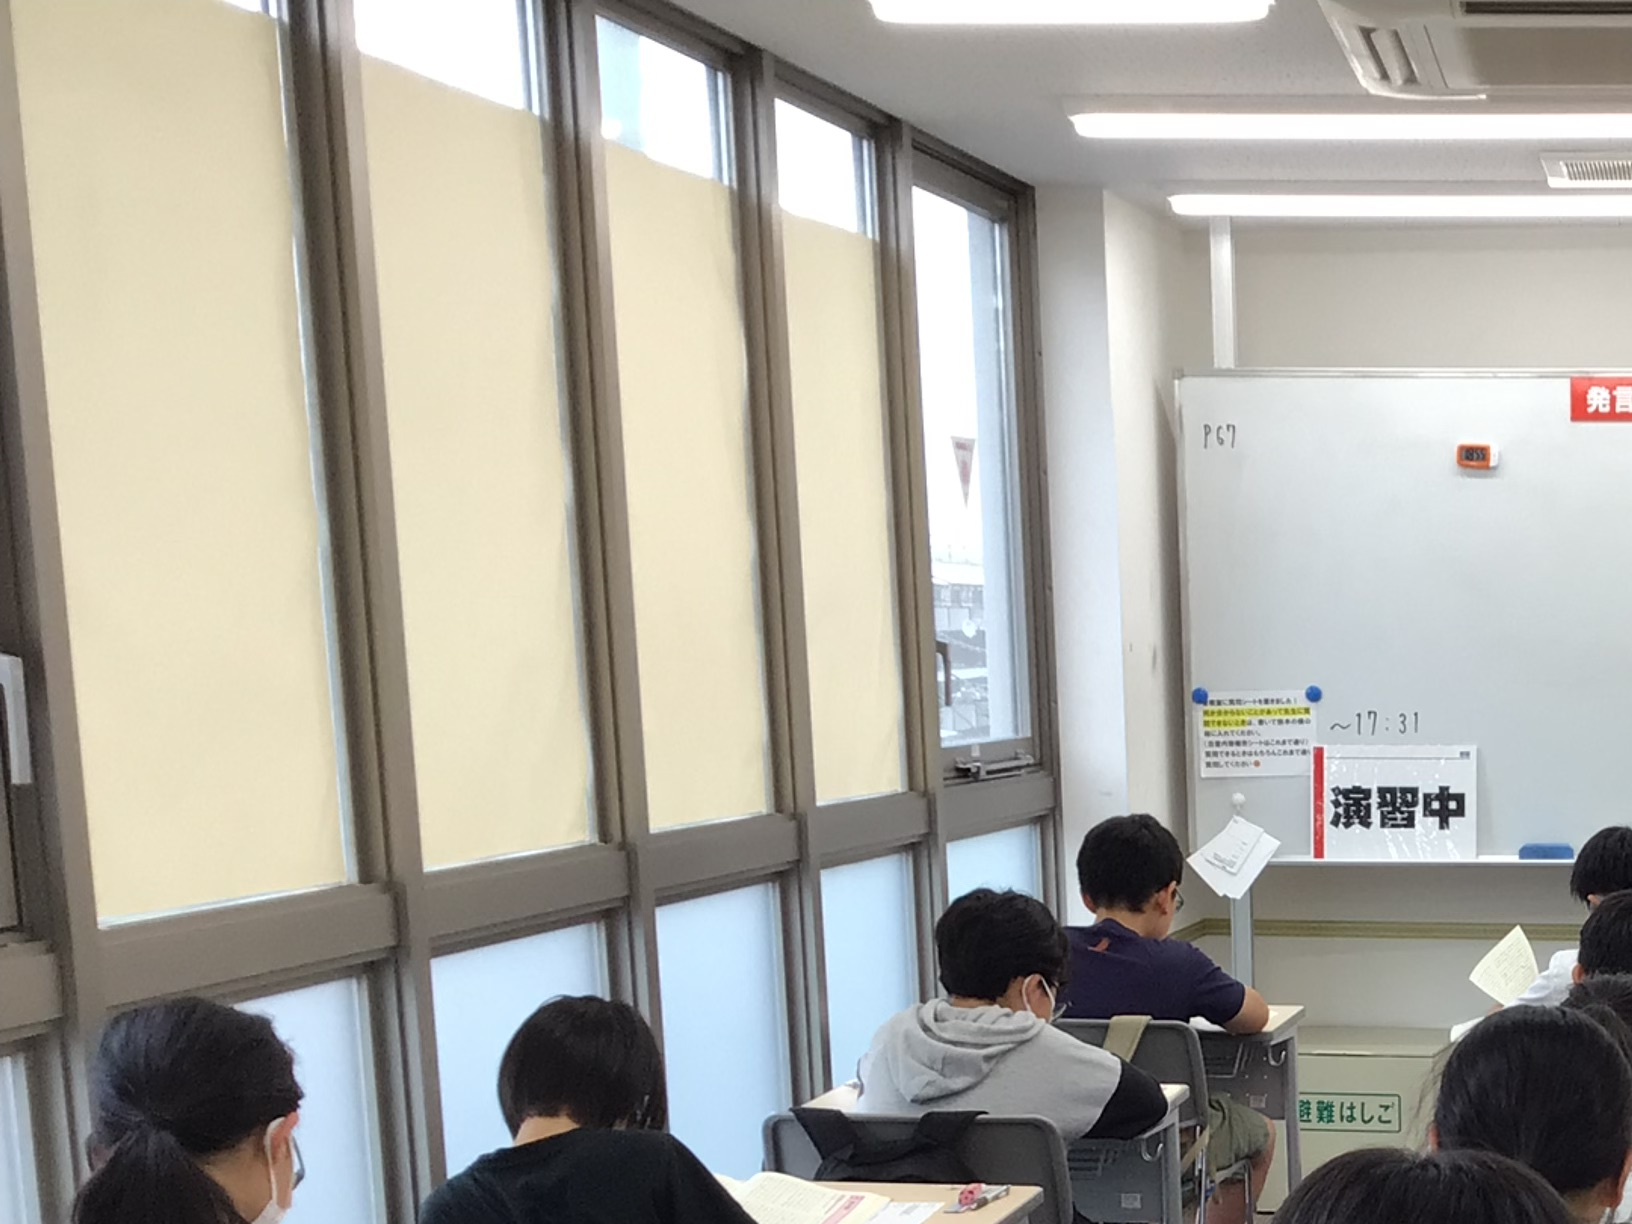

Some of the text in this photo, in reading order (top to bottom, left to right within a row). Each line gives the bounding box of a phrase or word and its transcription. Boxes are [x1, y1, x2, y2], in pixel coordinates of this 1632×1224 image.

[1203, 423, 1236, 449] P67
[1329, 785, 1466, 830] 演習中
[1299, 1099, 1395, 1124] 避難はしご
